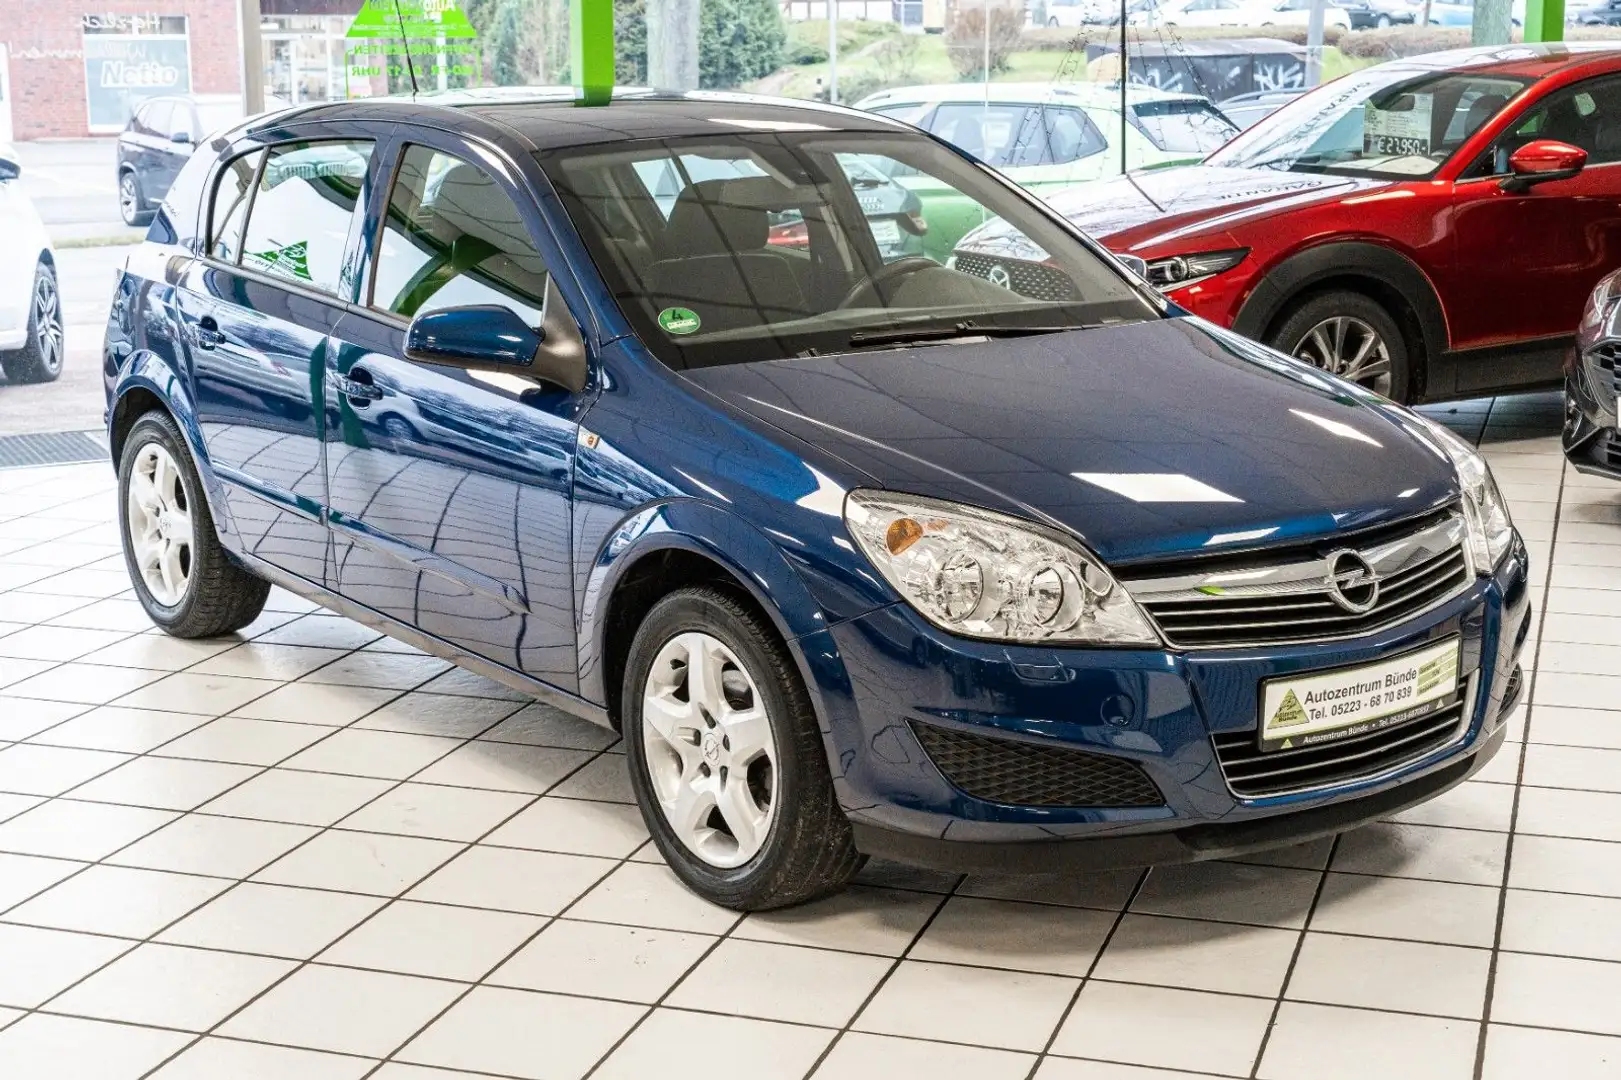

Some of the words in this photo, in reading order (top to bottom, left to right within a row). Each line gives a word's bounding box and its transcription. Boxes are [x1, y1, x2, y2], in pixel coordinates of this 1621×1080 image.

[102, 61, 178, 87] Netto
[672, 309, 684, 321] 4
[1304, 679, 1382, 705] Autozentrum
[1385, 667, 1417, 688] Bünde
[1309, 706, 1328, 721] Tel.
[1331, 700, 1361, 716] 05223
[1370, 695, 1382, 708] 68
[1384, 691, 1395, 704] 70
[1396, 686, 1412, 701] 839
[1303, 730, 1348, 744] Autozentrum
[1348, 723, 1369, 736] Bünde
